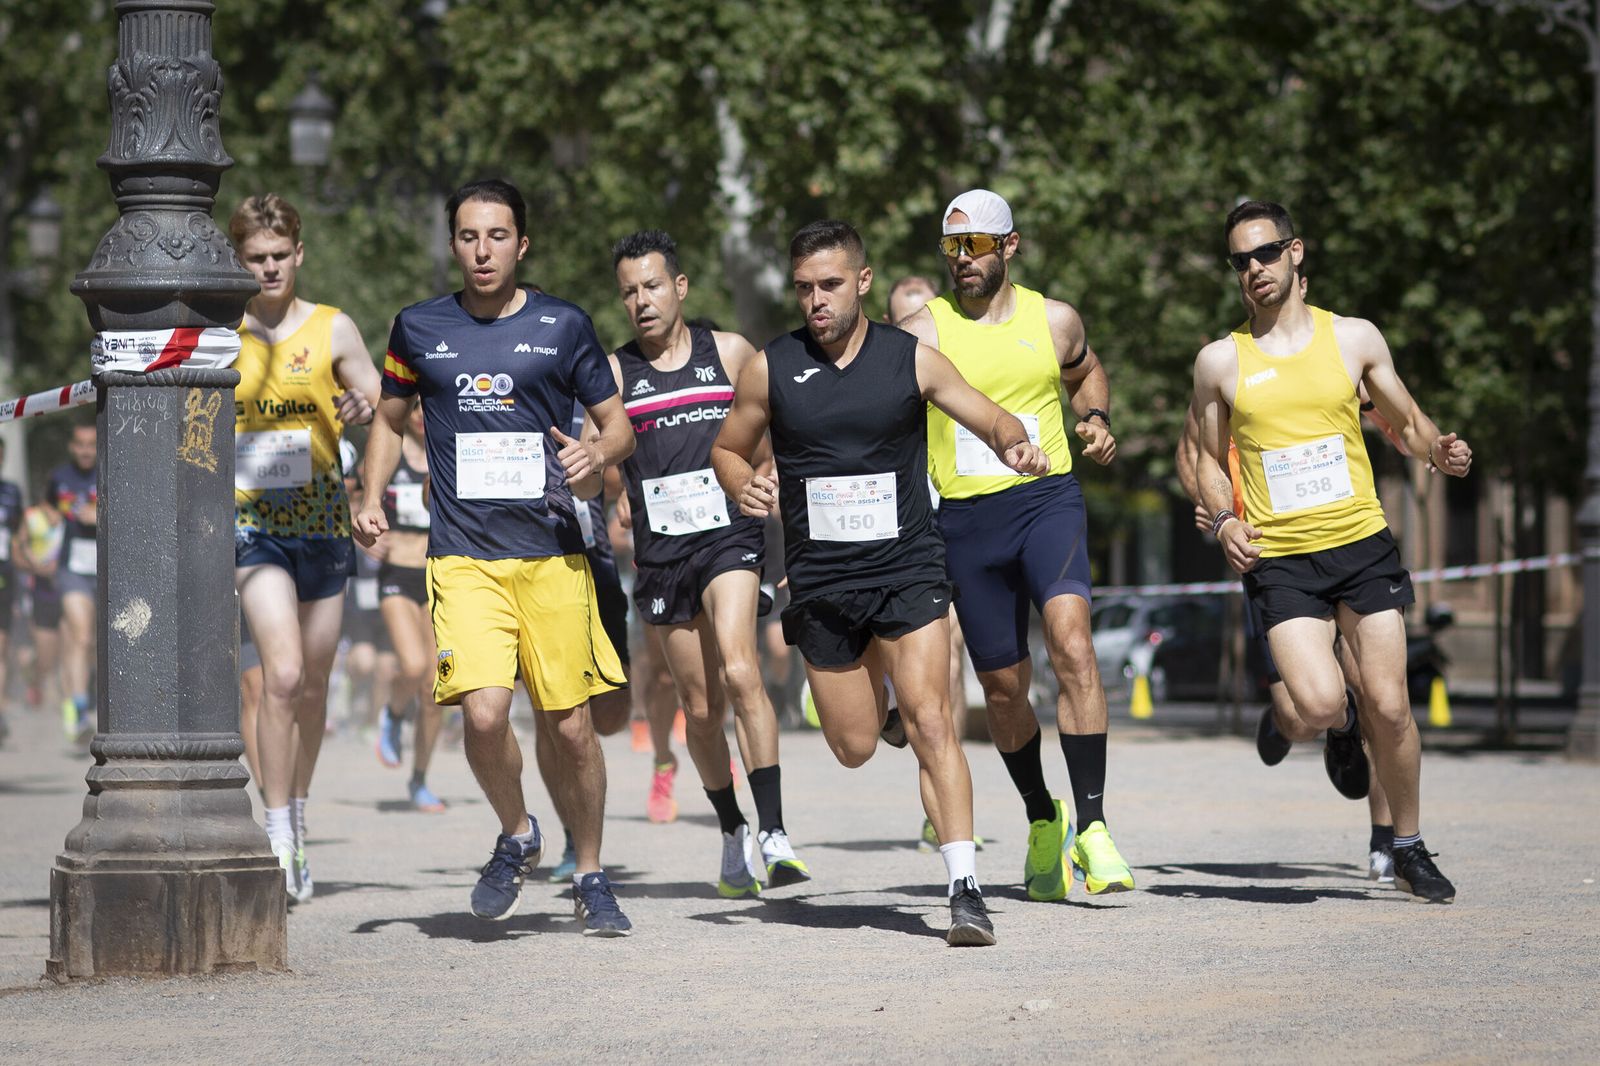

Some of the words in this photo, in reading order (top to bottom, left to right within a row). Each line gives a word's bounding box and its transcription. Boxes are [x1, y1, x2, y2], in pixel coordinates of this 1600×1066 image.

[425, 352, 459, 360] Santander
[533, 346, 558, 356] mupol
[455, 373, 514, 397] 200
[255, 399, 317, 418] Vigilso
[459, 404, 516, 412] NACIONAL
[461, 448, 483, 456] alsa
[257, 463, 291, 479] 849
[1269, 463, 1290, 473] alsa
[484, 471, 523, 486] 544
[1295, 477, 1332, 498] 538
[811, 492, 834, 500] alsa
[836, 514, 875, 530] 150
